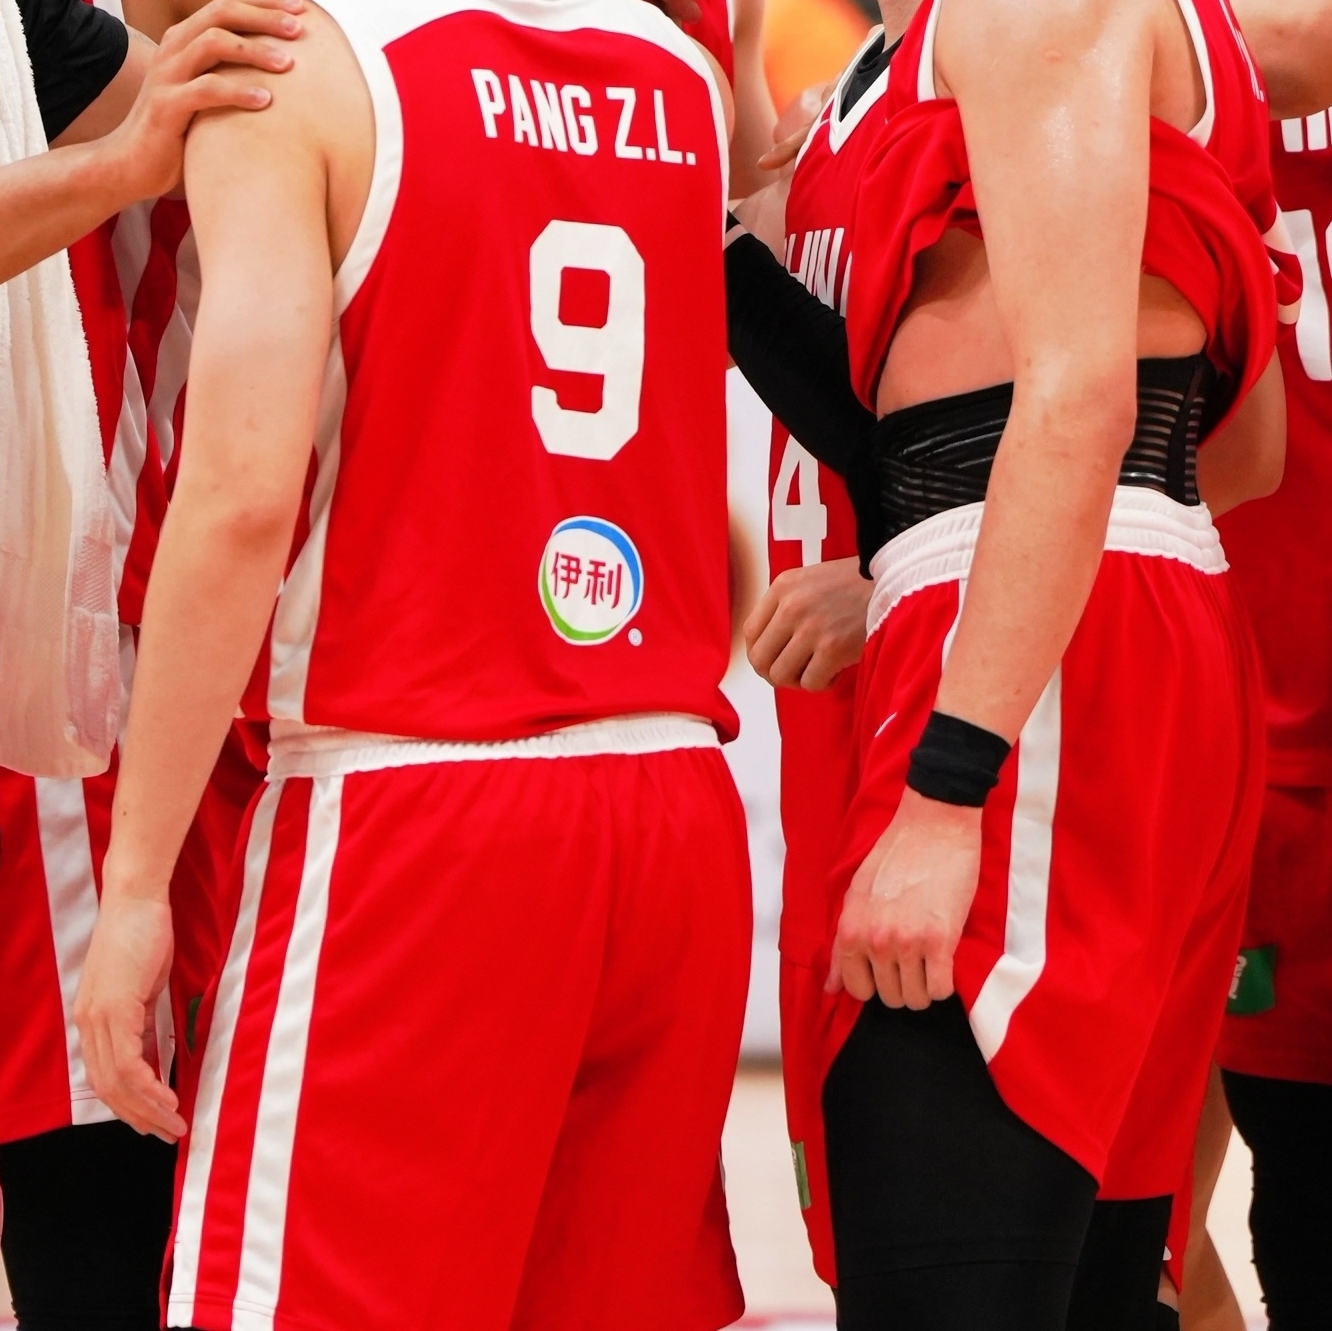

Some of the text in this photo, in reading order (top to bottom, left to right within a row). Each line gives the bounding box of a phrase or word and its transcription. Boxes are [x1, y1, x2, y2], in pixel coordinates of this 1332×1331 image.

[470, 68, 697, 166] PANG Z.L.
[529, 219, 645, 461] 9
[551, 551, 623, 609] 伊利
